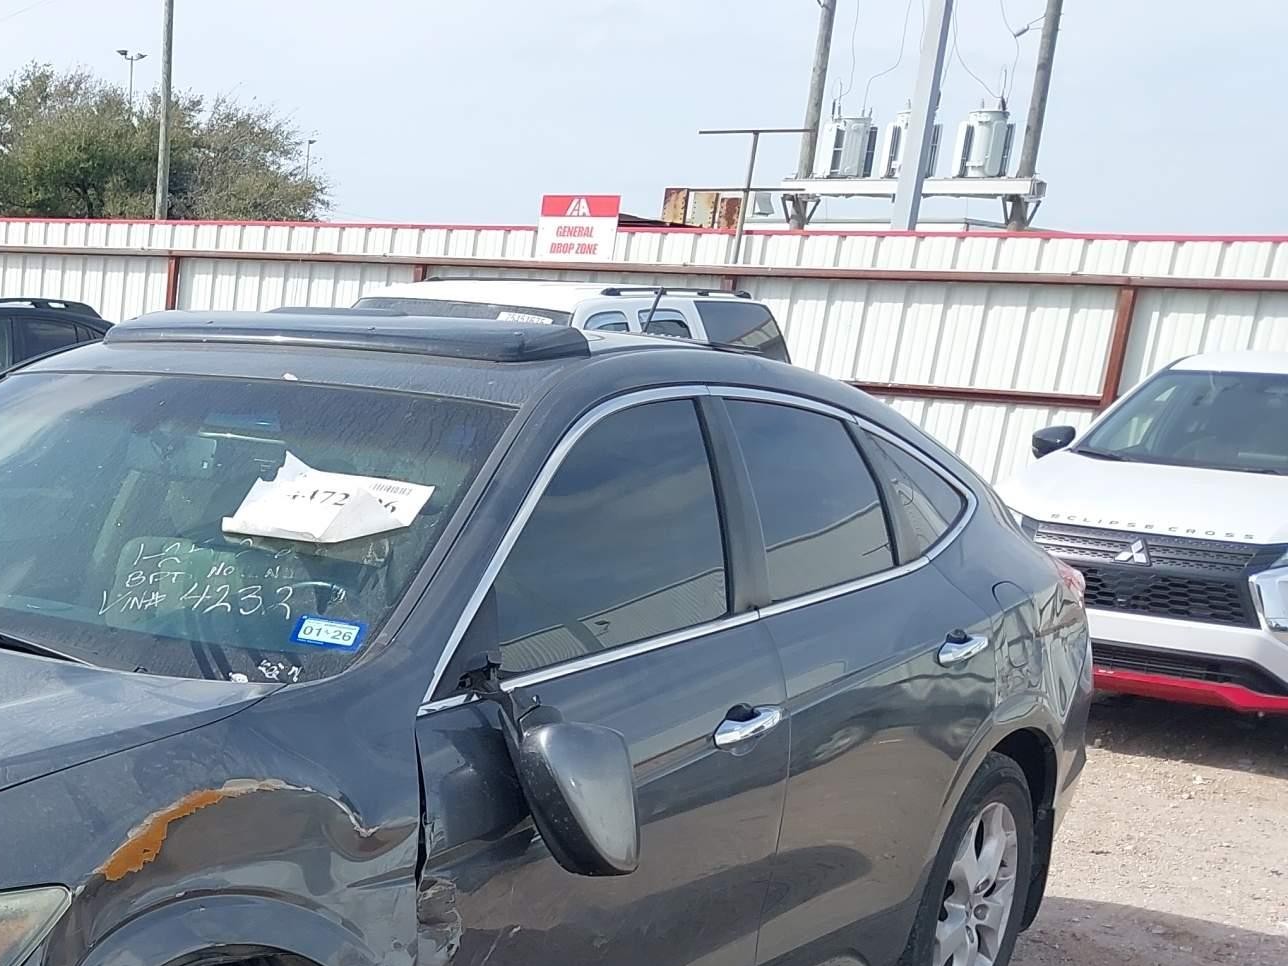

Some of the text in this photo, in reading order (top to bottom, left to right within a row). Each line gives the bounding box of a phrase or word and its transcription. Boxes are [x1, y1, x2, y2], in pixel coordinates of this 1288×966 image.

[556, 225, 594, 238] GENERAL
[549, 242, 599, 255] DROP ZONE
[1050, 513, 1255, 539] ECLIPSE CROSS
[98, 590, 167, 616] VIN#
[302, 624, 323, 638] 01
[330, 628, 353, 643] 26
